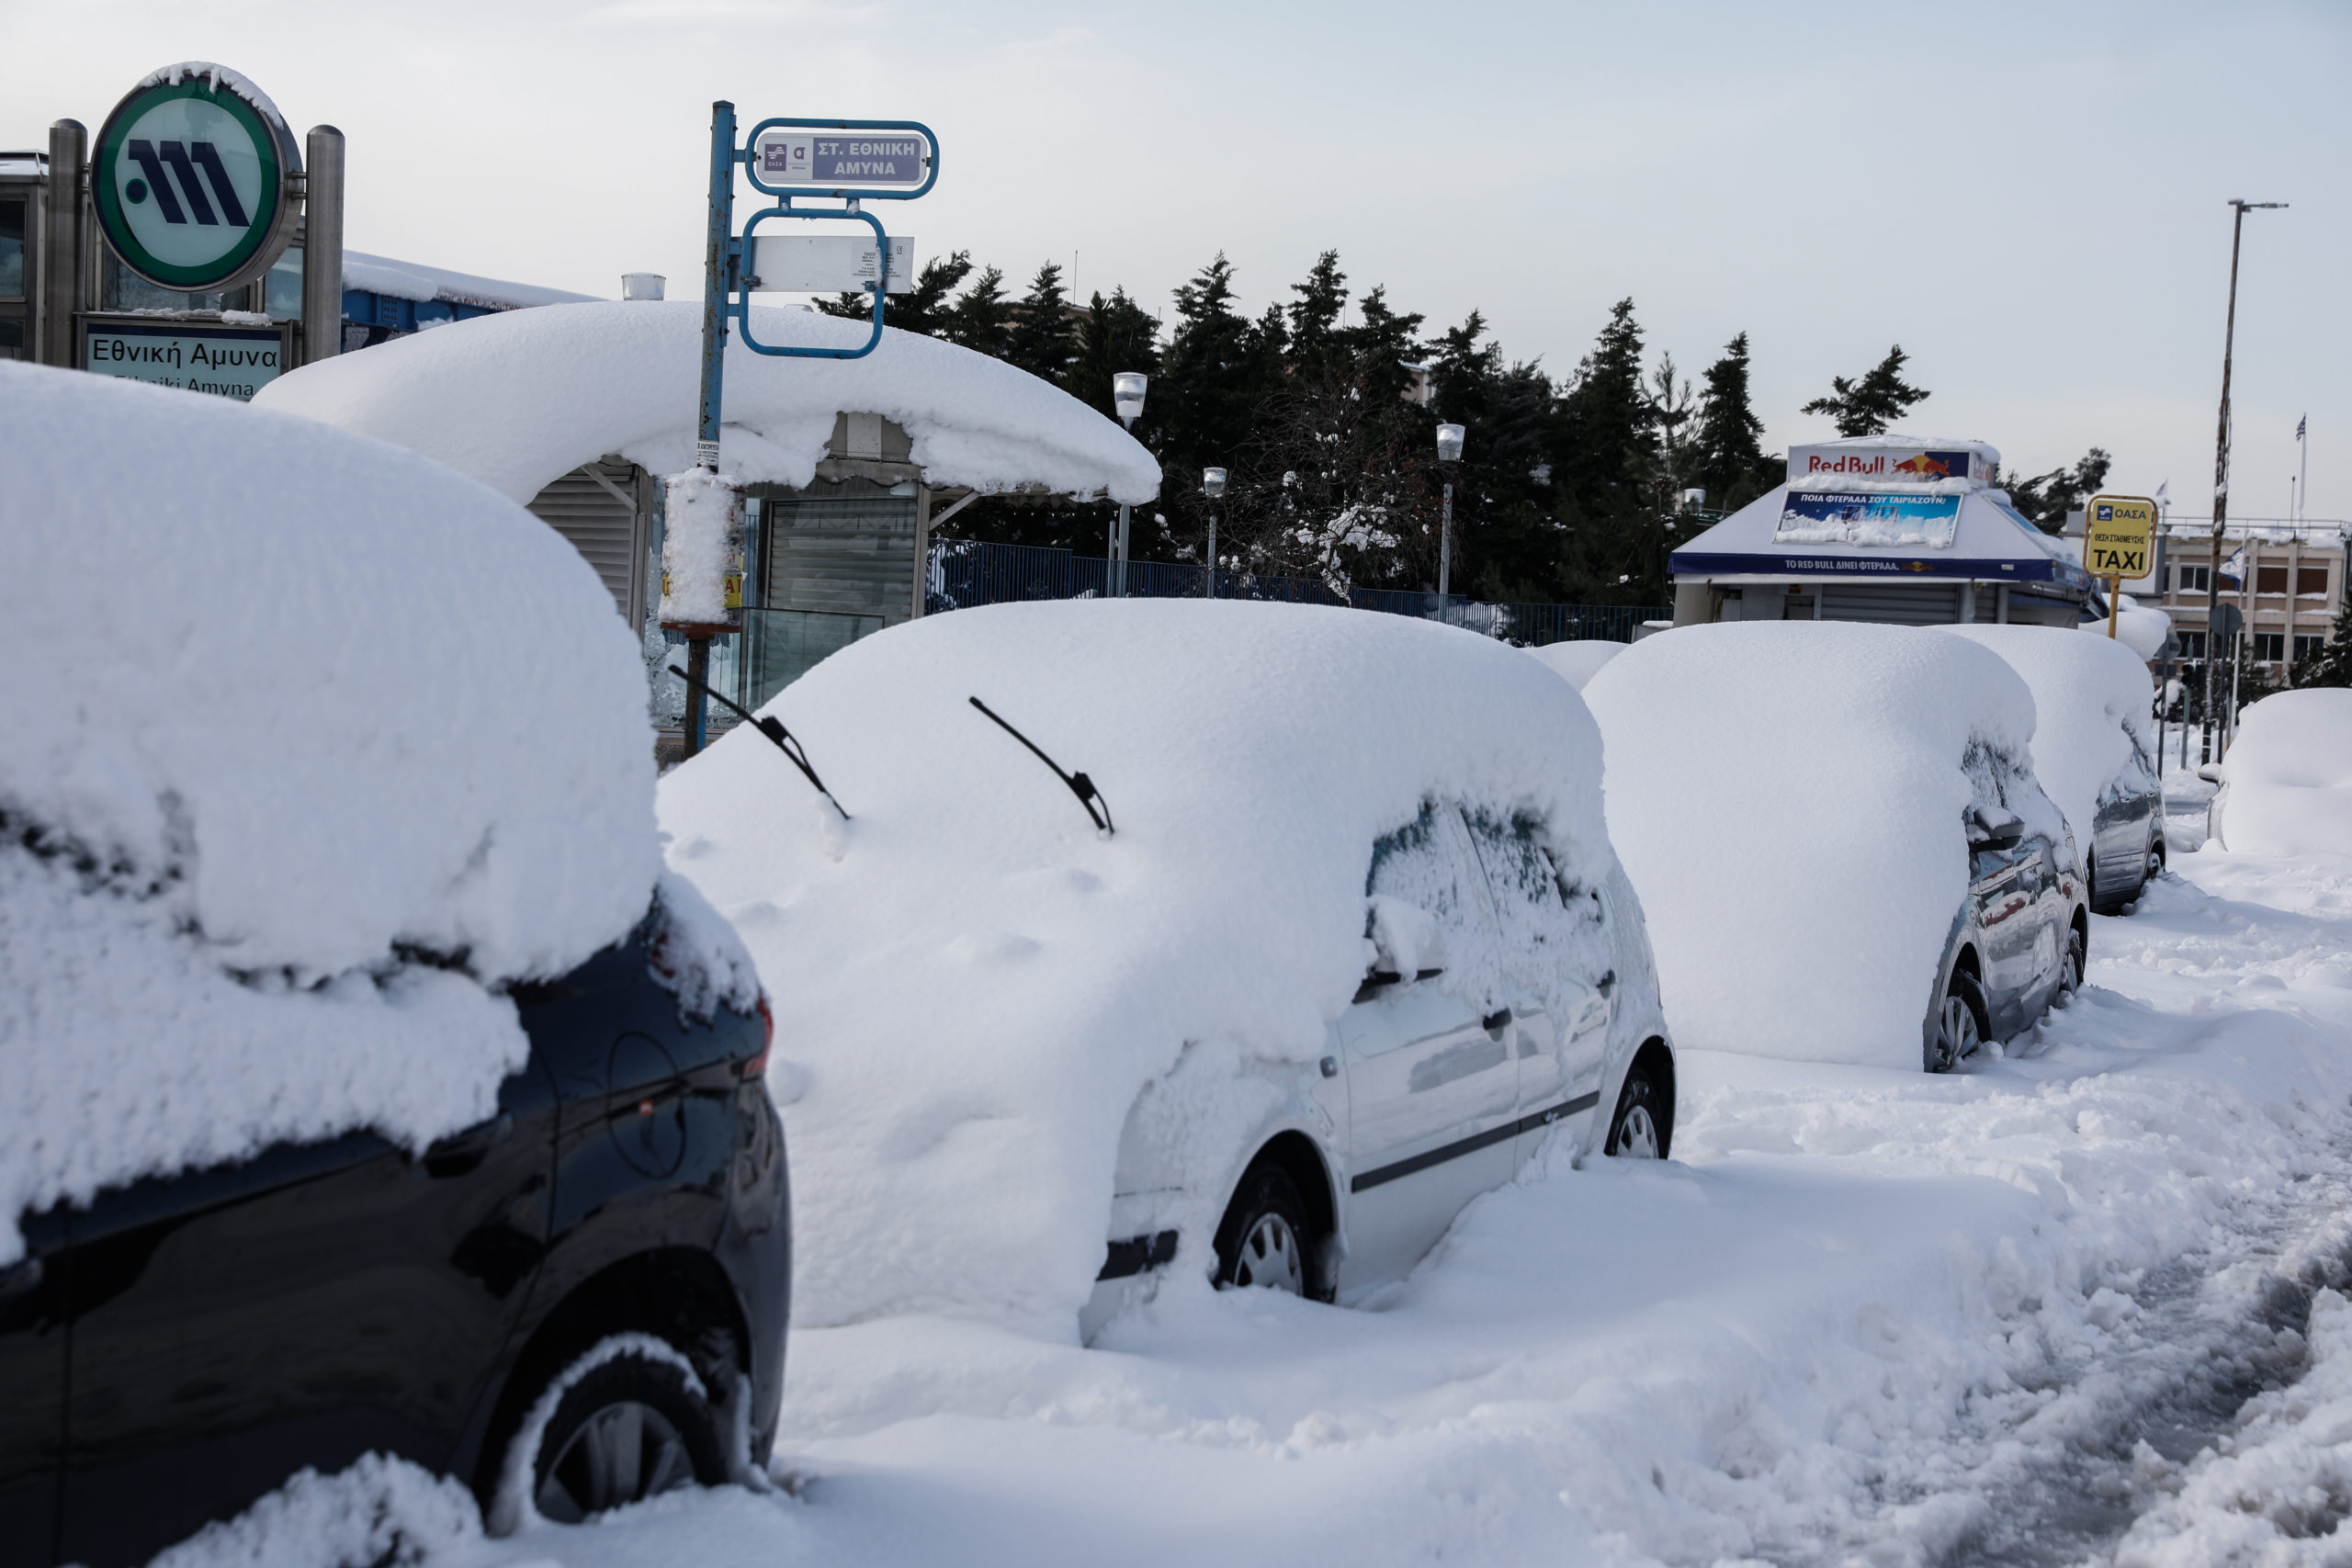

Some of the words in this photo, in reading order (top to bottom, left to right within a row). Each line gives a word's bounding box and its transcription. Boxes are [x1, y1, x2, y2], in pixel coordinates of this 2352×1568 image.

[818, 142, 843, 155] ΣΤ.
[849, 142, 915, 156] ΕΘΝΙΚΗ
[834, 162, 896, 175] ΑΜΥΝΑ
[93, 339, 182, 369] Εθνική
[190, 343, 277, 370] Αμυνα
[187, 378, 254, 398] Amyna
[1808, 456, 1846, 473] Red
[1849, 456, 1885, 474] Bull
[1801, 494, 1824, 502] ΠΟΙΑ
[1826, 495, 1866, 503] ΦΤΕΡΑΑΑ
[1868, 496, 1888, 504] ΣΟΥ
[2115, 509, 2146, 520] ΟΑΣΑ
[2094, 533, 2109, 542] ΘΕΣΗ
[2109, 535, 2145, 544] ΣΤΑΘΜΕΥΣΗΣ
[1785, 559, 1797, 569] ΤΟ
[1798, 560, 1814, 569] RED
[1815, 560, 1835, 570] BULL
[1837, 561, 1858, 570] ΔΙΝΕΙ
[2093, 549, 2144, 570] TAXI
